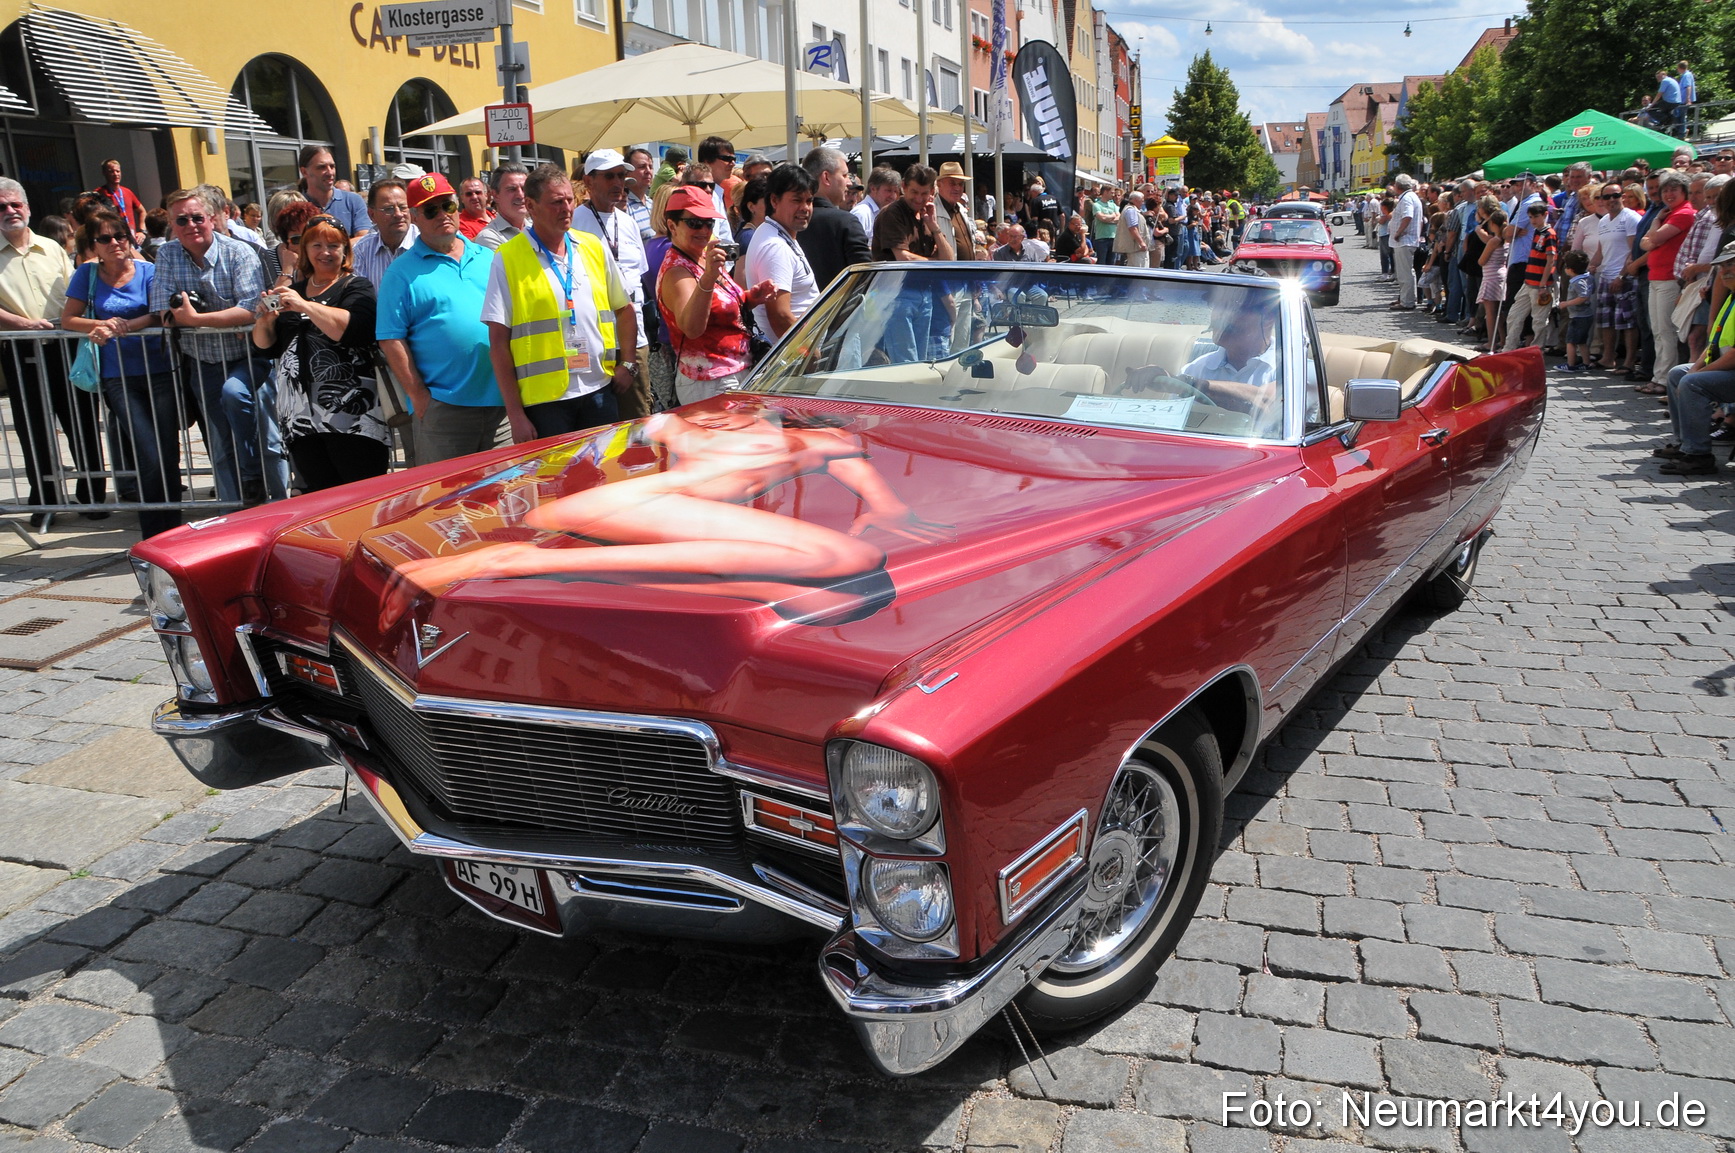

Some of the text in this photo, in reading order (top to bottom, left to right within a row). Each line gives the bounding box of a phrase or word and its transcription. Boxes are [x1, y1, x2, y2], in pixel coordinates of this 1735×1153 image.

[388, 7, 484, 29] Klostergasse
[490, 108, 520, 119] H 200
[1130, 106, 1141, 161] HOTEL
[1539, 139, 1617, 152] Lammsbräu
[1552, 136, 1608, 145] Neumarkter
[1126, 404, 1175, 413] 234
[605, 785, 699, 816] Cadillac
